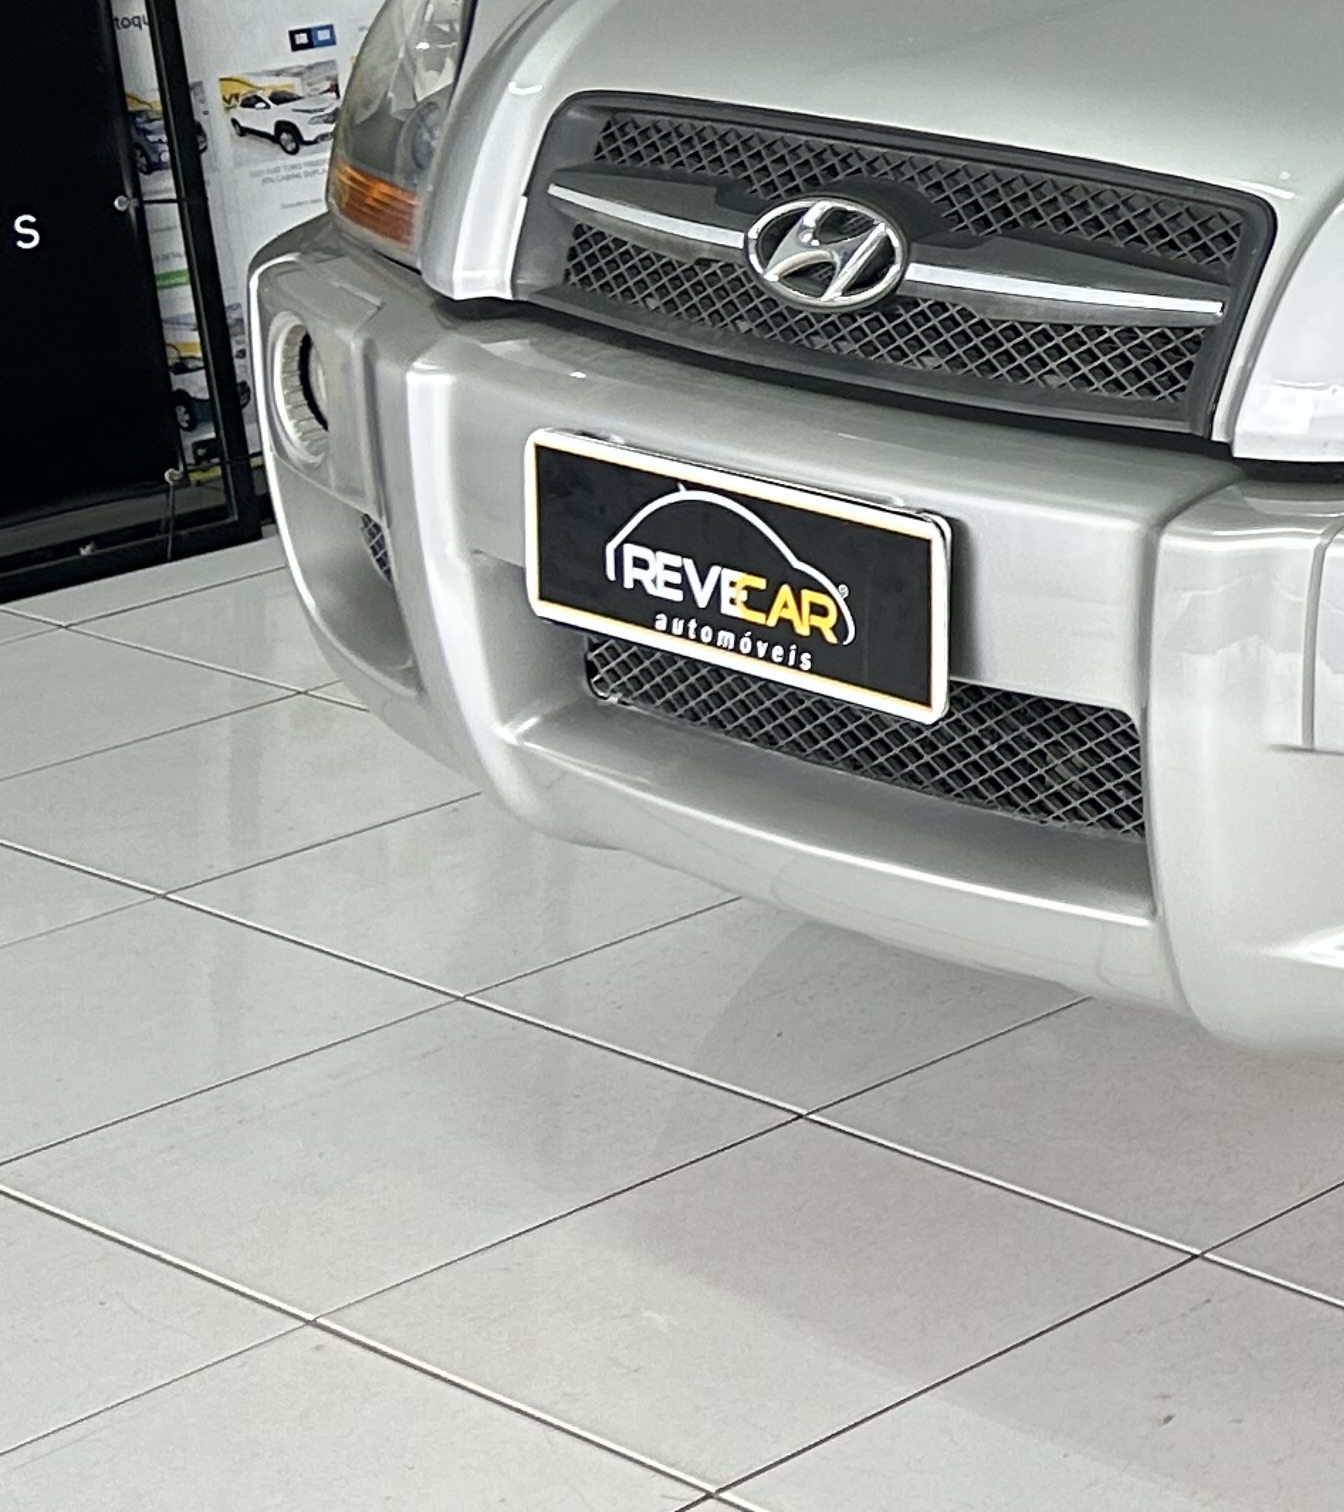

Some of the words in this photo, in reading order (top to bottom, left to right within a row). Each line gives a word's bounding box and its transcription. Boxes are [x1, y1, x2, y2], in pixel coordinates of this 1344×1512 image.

[13, 213, 41, 250] S
[622, 542, 839, 644] REVECAR
[654, 611, 813, 671] automóveis
